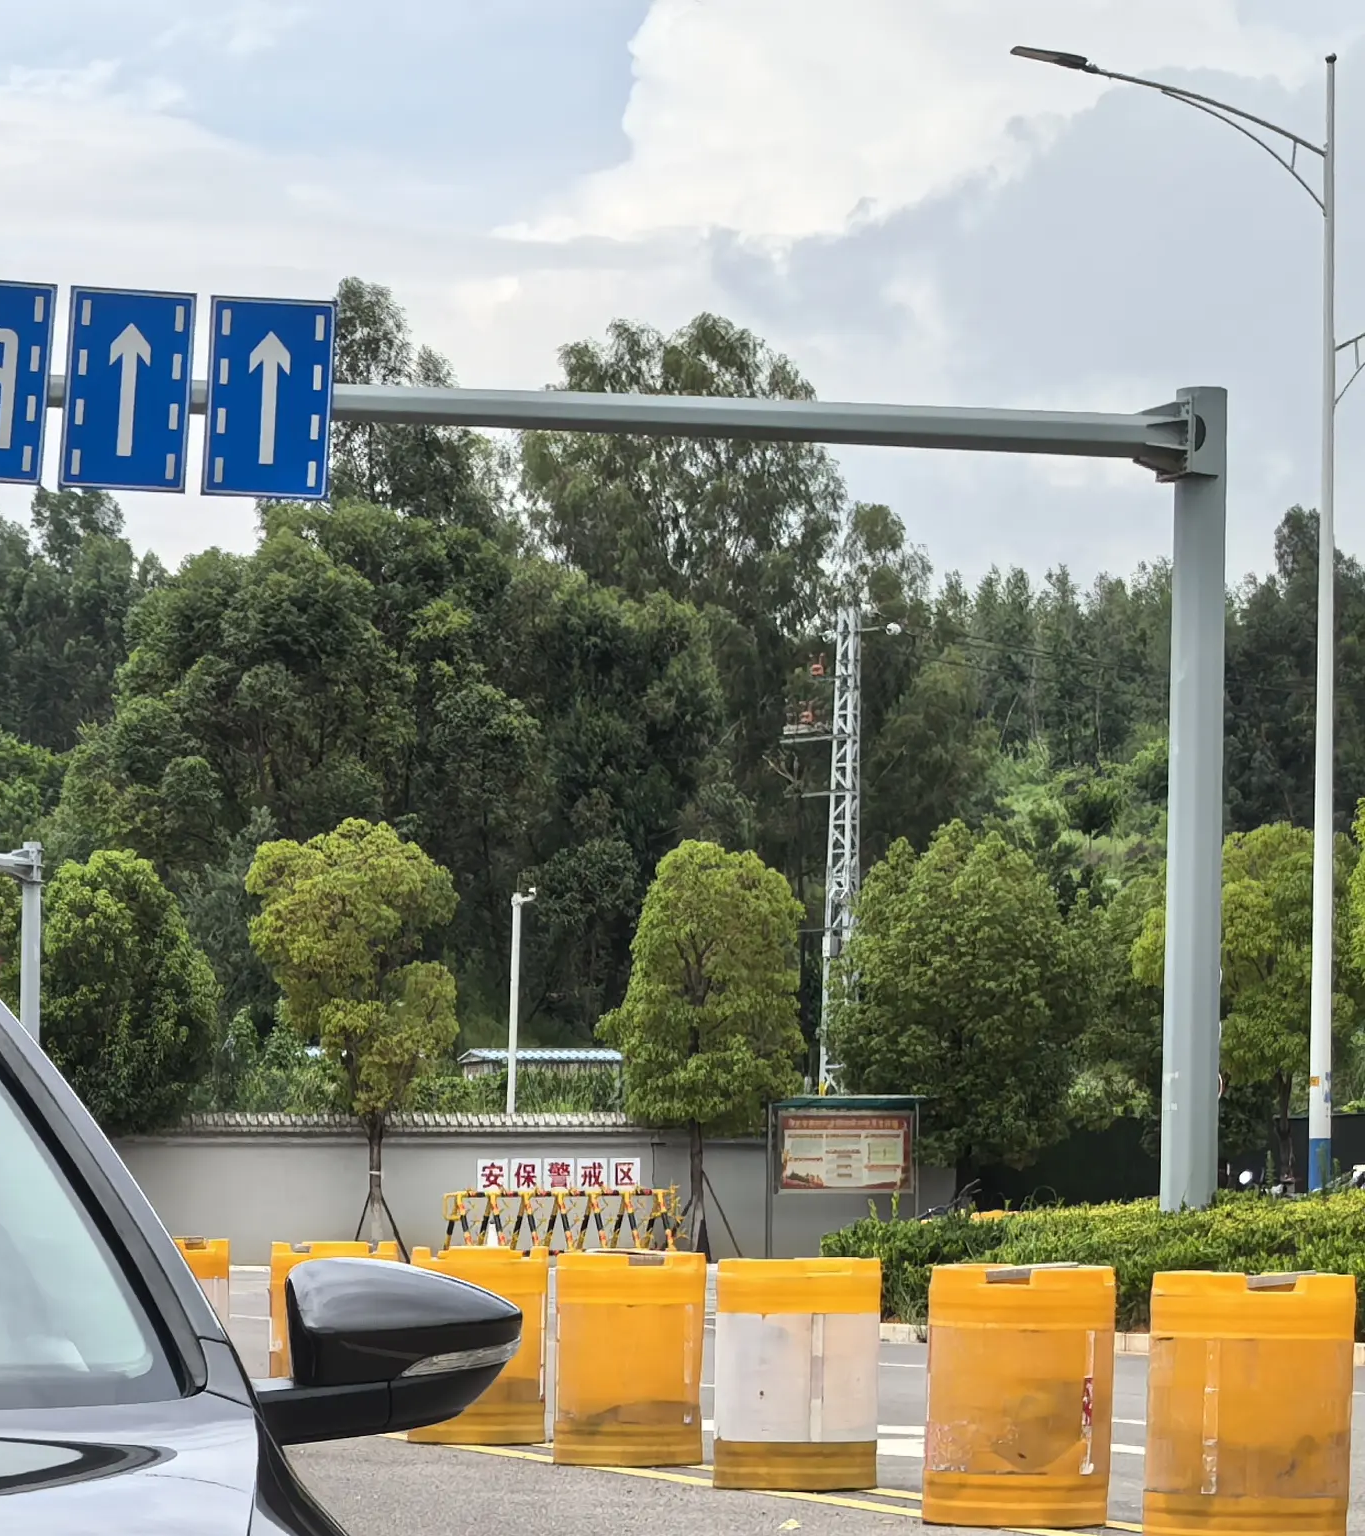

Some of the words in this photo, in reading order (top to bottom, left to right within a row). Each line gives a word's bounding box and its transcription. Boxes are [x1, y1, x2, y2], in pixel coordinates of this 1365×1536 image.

[480, 1161, 636, 1189] 安保警戒区
